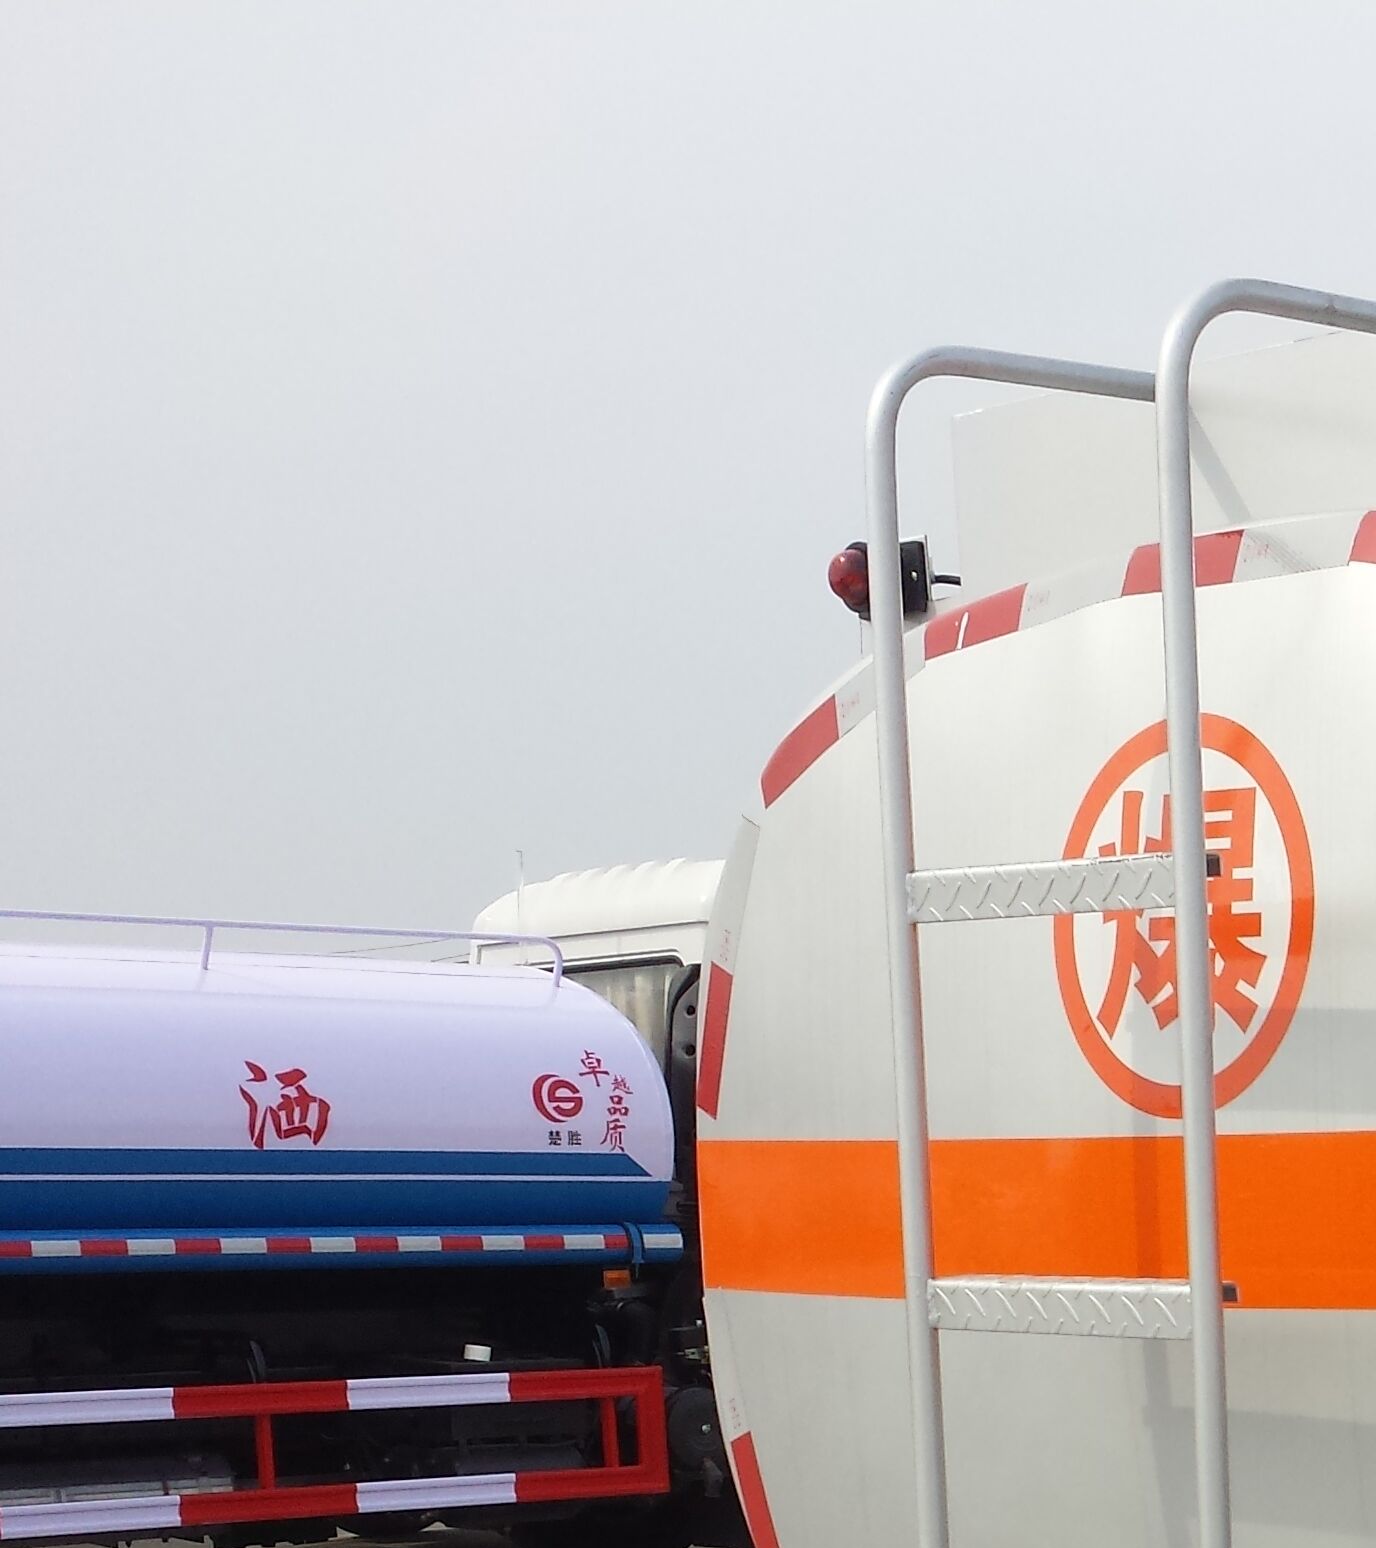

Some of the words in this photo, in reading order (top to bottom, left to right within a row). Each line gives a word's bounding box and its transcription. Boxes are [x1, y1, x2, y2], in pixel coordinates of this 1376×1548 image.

[1097, 786, 1268, 1040] 爆
[239, 1060, 331, 1150] 洒
[548, 1130, 582, 1146] 楚胜
[579, 1049, 634, 1152] 卓越品质
